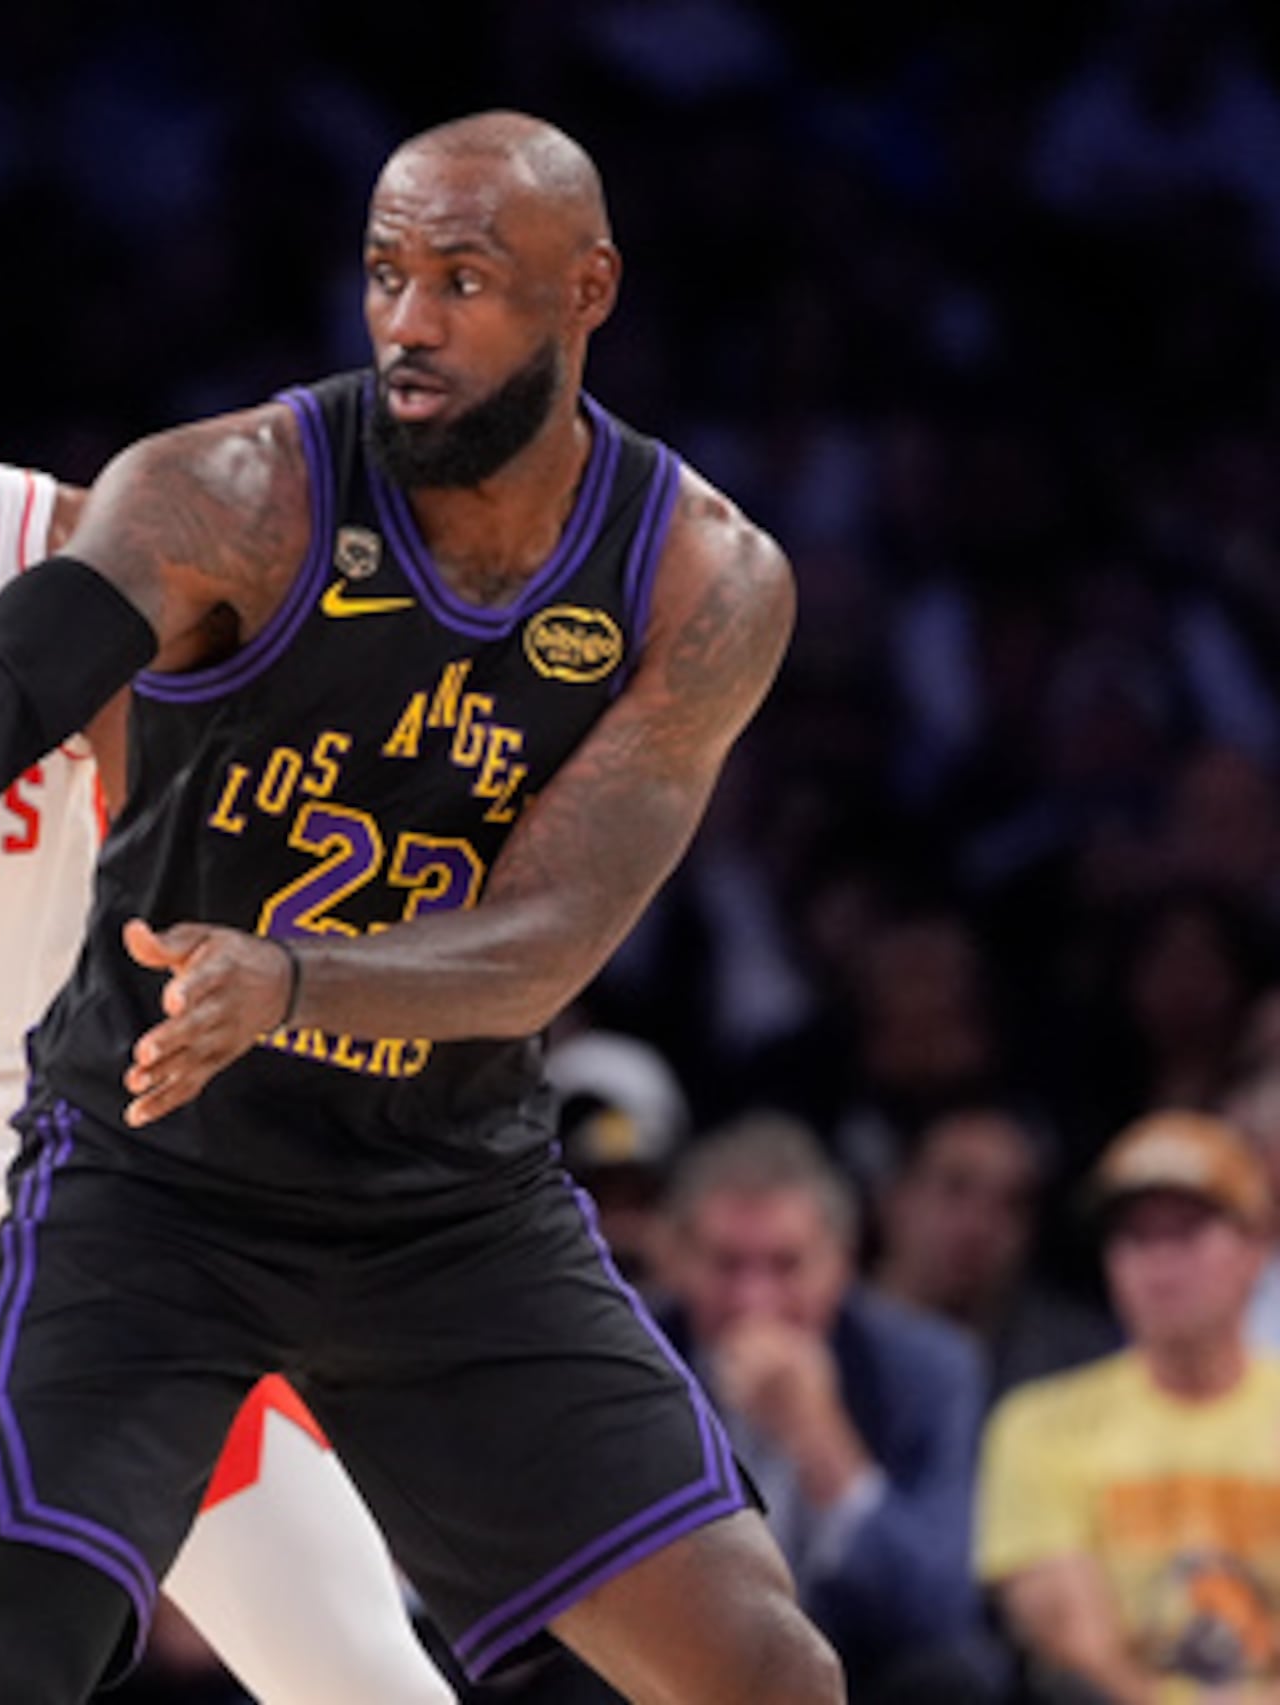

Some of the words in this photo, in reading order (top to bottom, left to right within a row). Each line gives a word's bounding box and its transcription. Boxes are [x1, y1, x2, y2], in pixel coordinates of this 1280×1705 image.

[208, 732, 352, 834] LOS
[382, 658, 532, 824] ANGEL
[256, 801, 485, 938] 23
